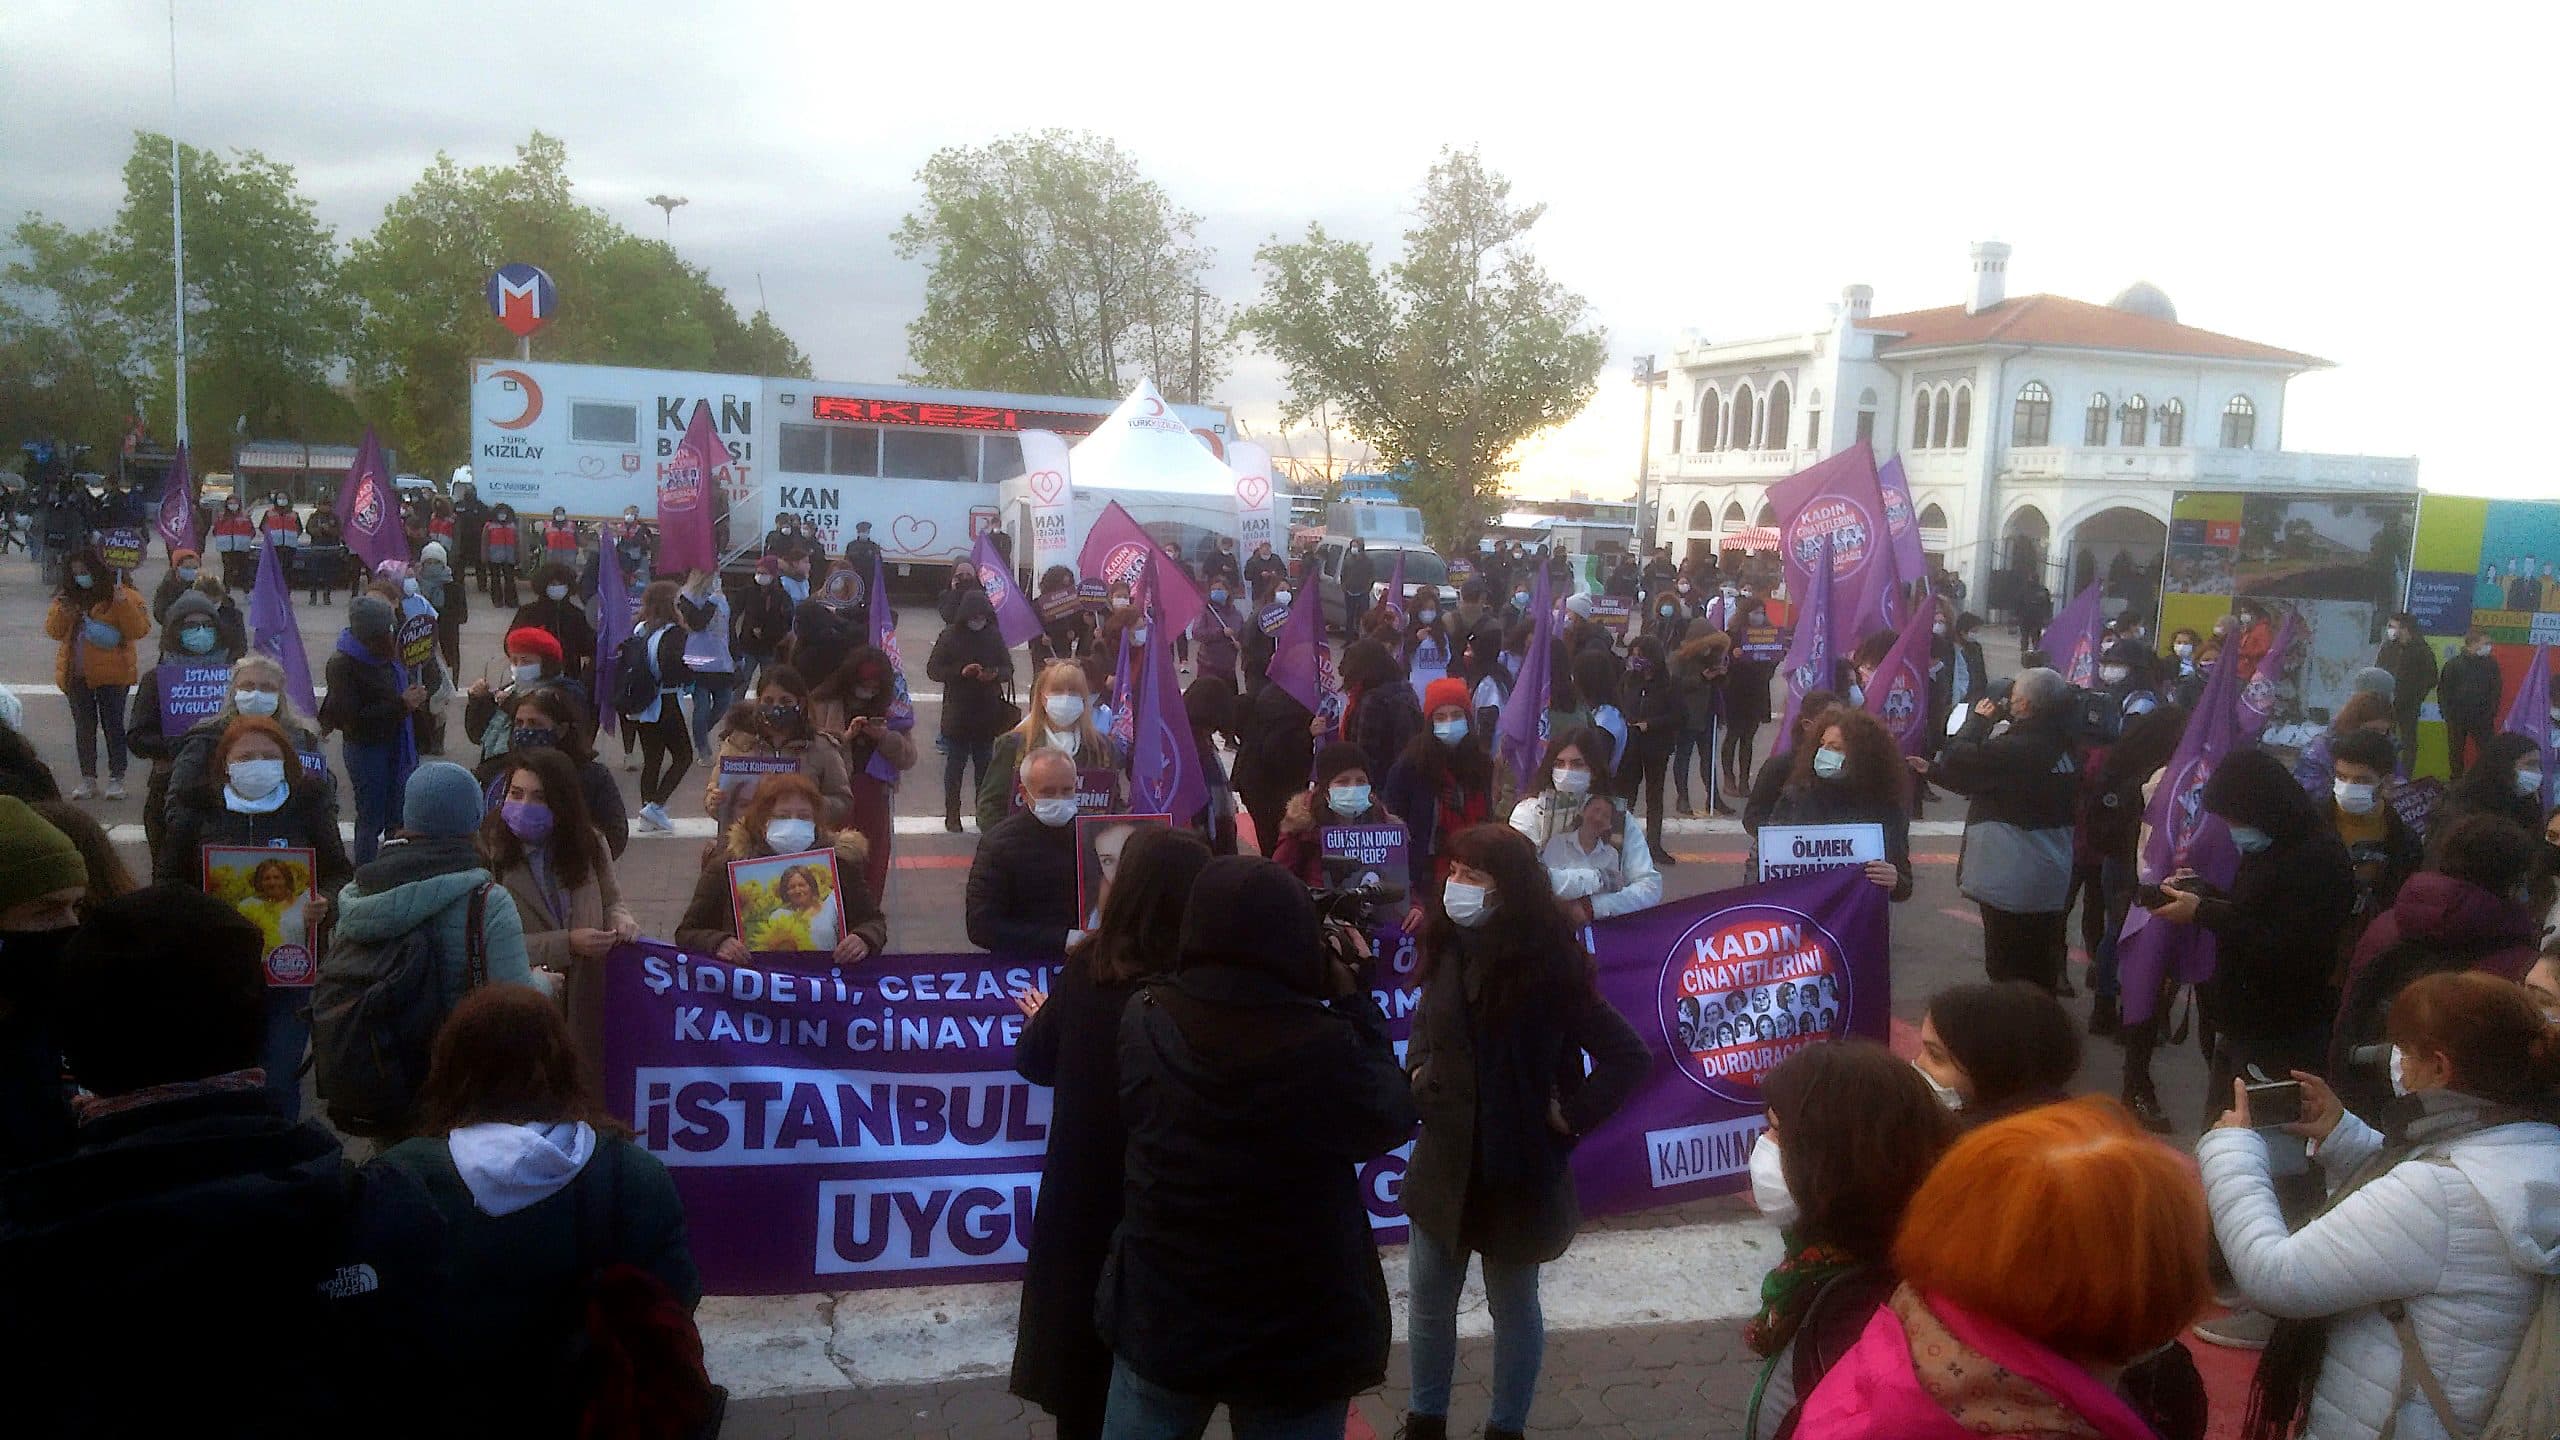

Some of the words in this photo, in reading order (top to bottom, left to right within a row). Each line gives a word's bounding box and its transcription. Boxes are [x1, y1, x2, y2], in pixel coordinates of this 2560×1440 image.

[498, 273, 540, 318] M
[780, 486, 839, 510] KAN
[1801, 503, 1846, 525] KADIN
[1105, 546, 1130, 576] KADIN
[1375, 830, 1402, 846] DOKU
[1792, 835, 1854, 858] ÖLMEK
[1694, 923, 1802, 964] KADIN
[643, 953, 863, 1006] ŞİDDETİ,
[878, 965, 1064, 1002] CEZASI
[1682, 944, 1823, 993] CİNAYETLERİNİ
[674, 1006, 828, 1048] KADIN
[647, 1080, 1047, 1153] İSTANBUL
[317, 1275, 360, 1293] NORTH
[336, 1265, 360, 1281] THE
[329, 1285, 360, 1301] FACE
